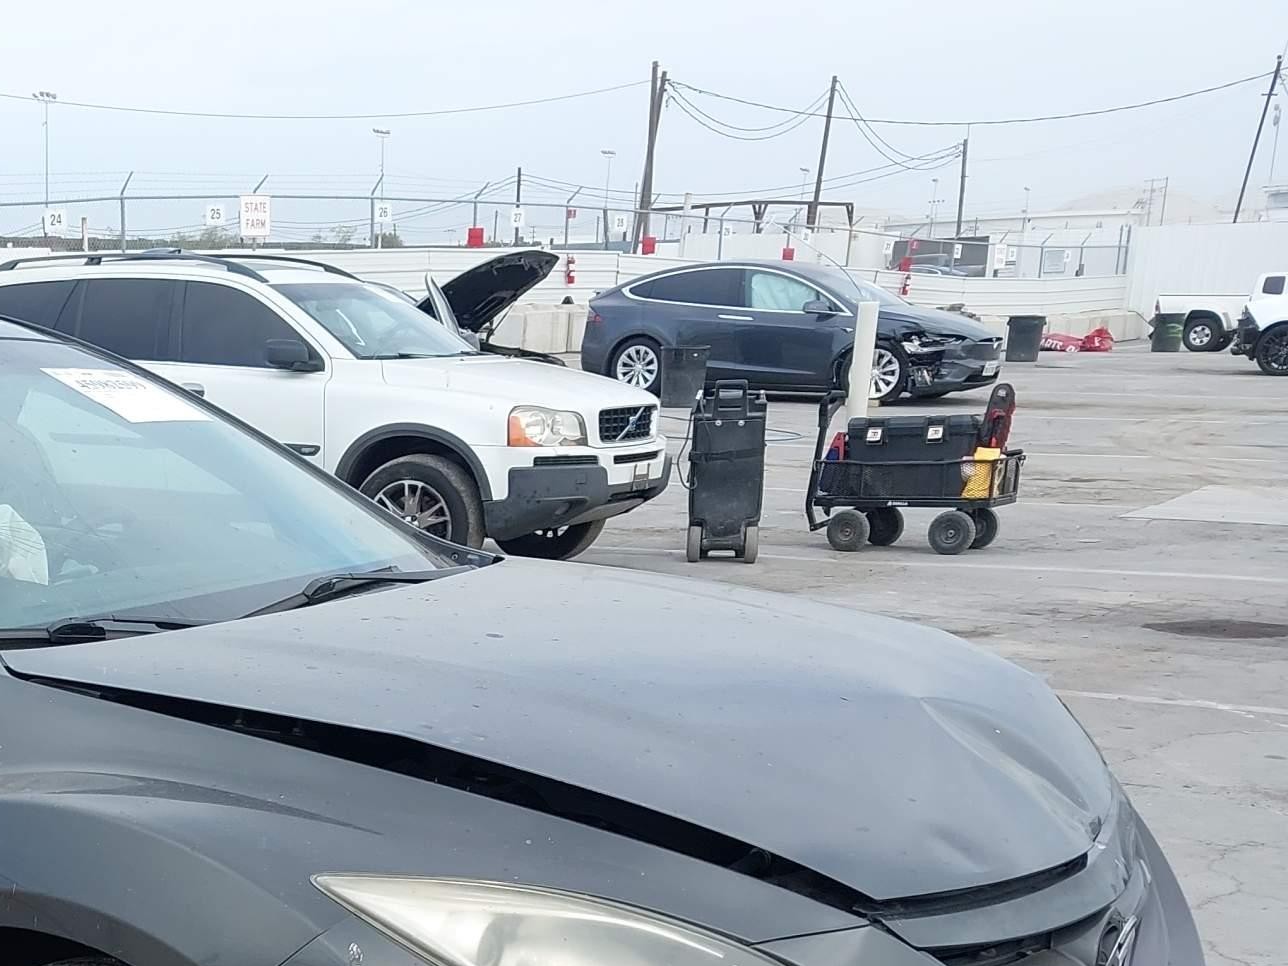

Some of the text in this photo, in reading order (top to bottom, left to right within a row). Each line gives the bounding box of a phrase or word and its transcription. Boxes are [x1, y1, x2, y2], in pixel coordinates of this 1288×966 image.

[210, 208, 221, 220] 25
[244, 202, 267, 214] STATE
[378, 207, 388, 218] 26
[50, 213, 62, 226] 24
[245, 218, 266, 229] FARM
